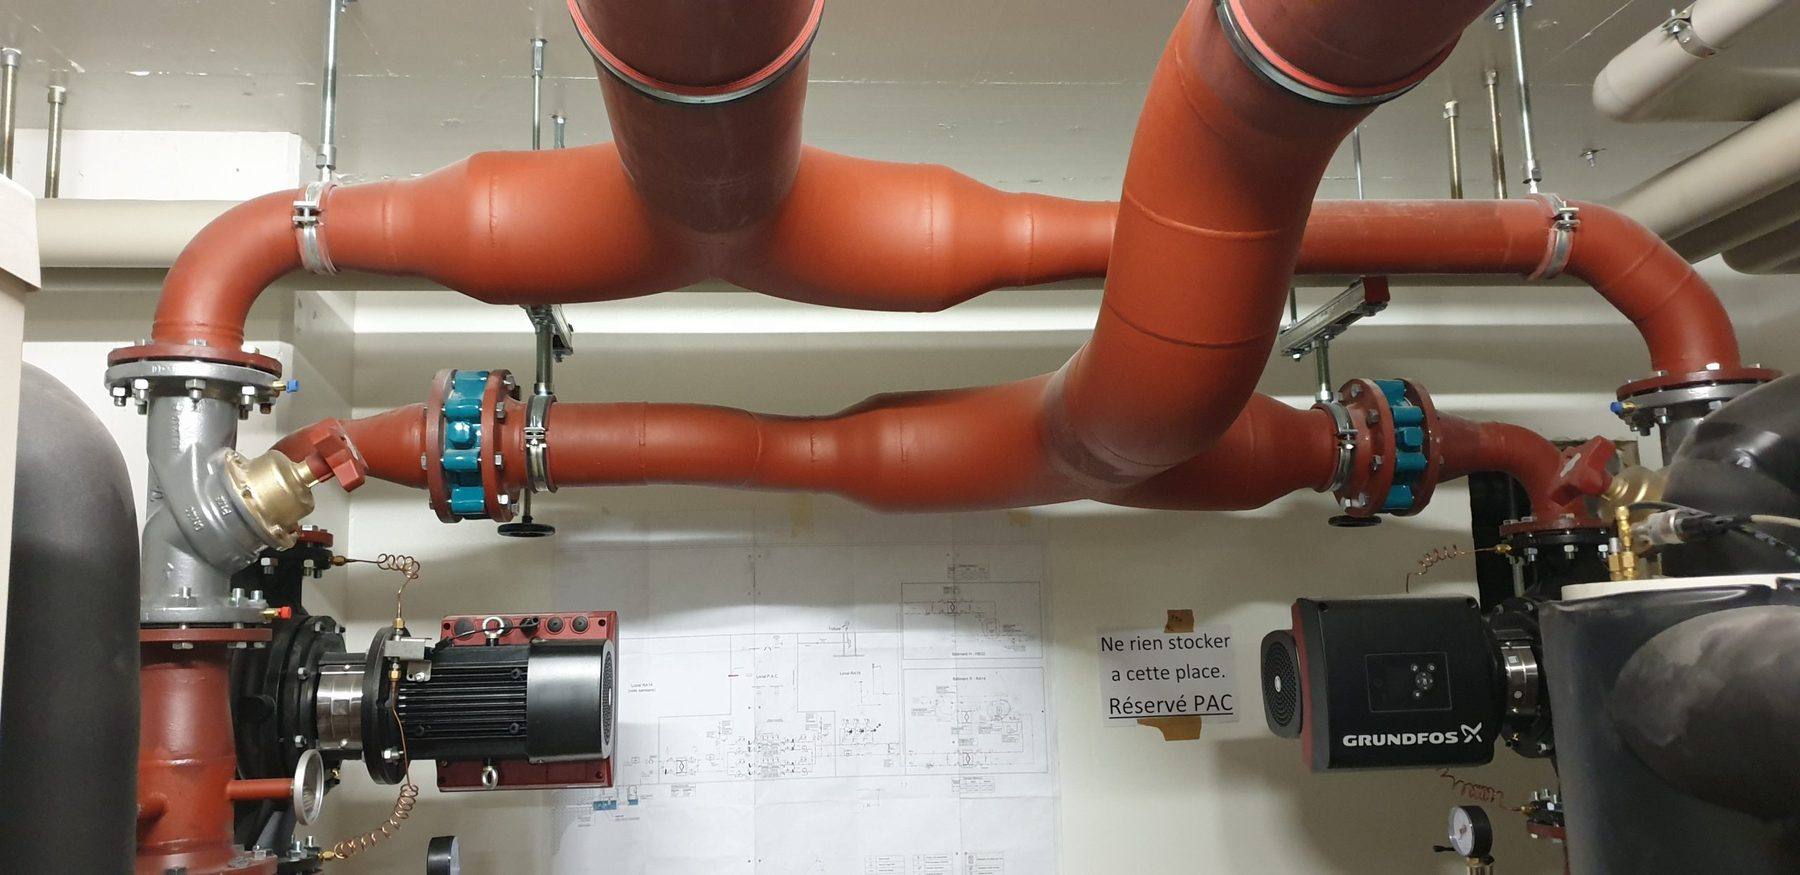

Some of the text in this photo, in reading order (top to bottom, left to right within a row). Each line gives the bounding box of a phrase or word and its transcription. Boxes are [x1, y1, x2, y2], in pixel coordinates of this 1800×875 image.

[1101, 633, 1231, 651] Ne rien stocker
[1111, 664, 1226, 683] a cette place.
[1109, 694, 1233, 715] Réservé PAC
[1342, 731, 1459, 747] GRUNDFOS
